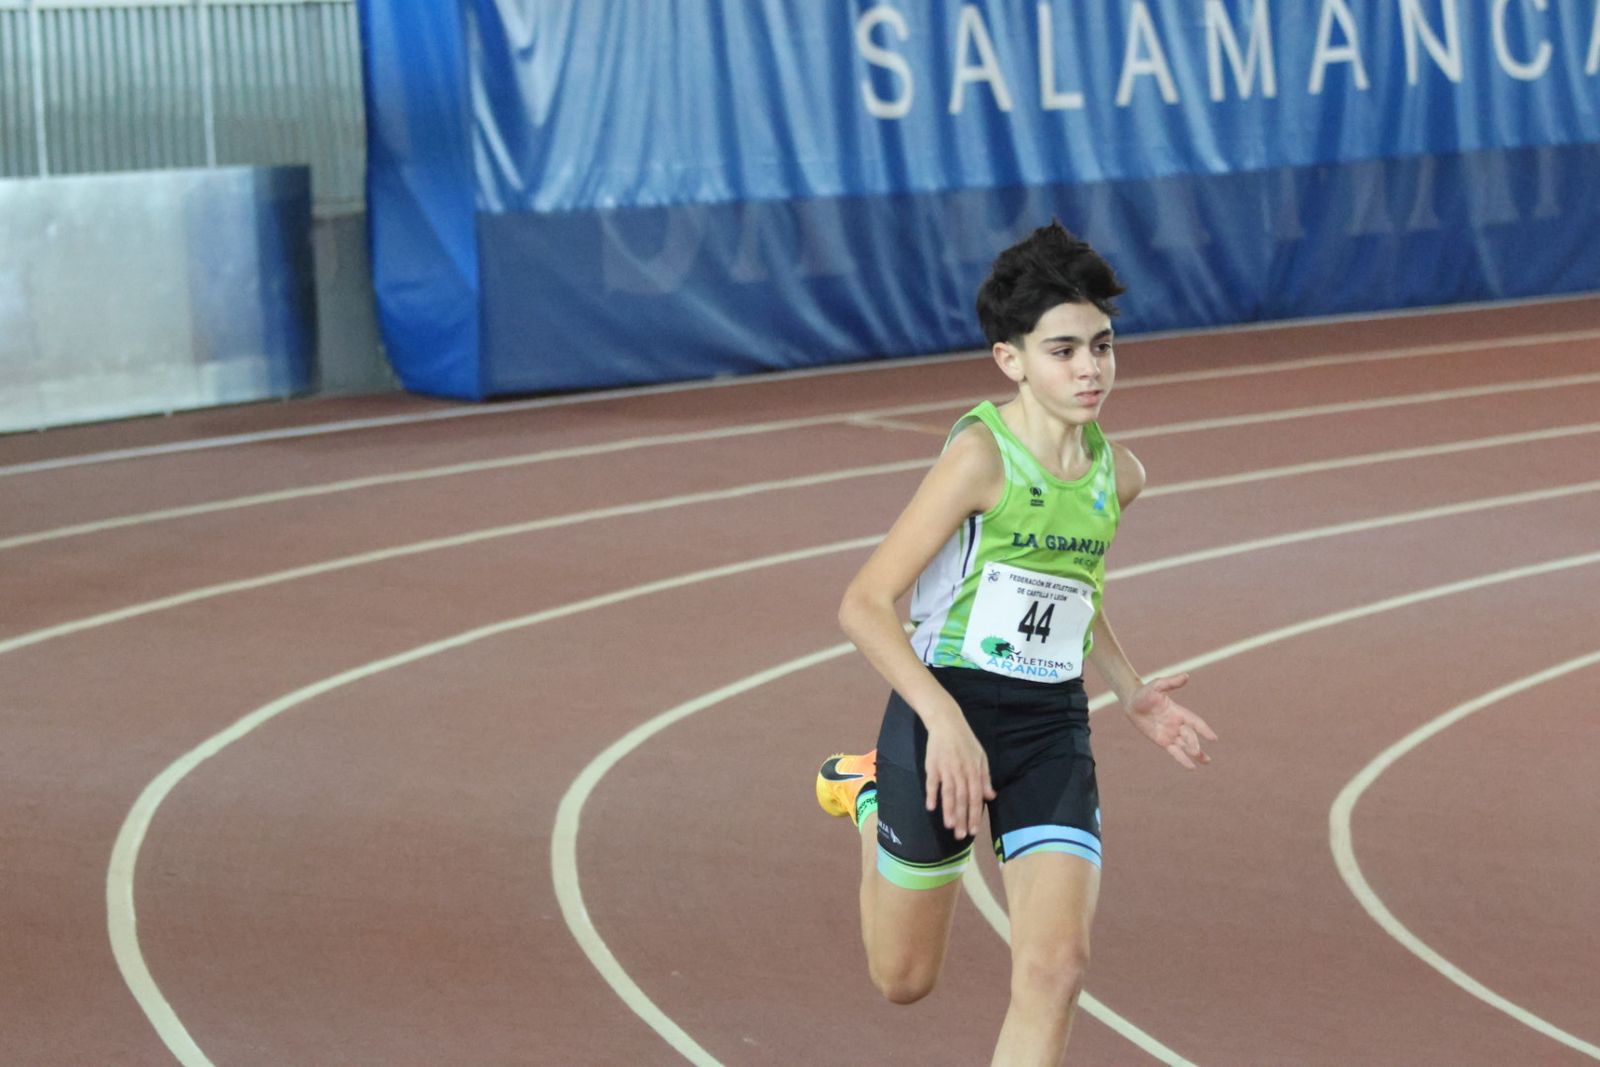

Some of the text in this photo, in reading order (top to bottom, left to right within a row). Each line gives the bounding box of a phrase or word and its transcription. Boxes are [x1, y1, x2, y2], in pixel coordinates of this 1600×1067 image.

[1011, 532, 1039, 549] LA
[1017, 600, 1055, 644] 44
[986, 656, 1059, 678] ARANDA
[1005, 654, 1073, 671] ATLETISMO
